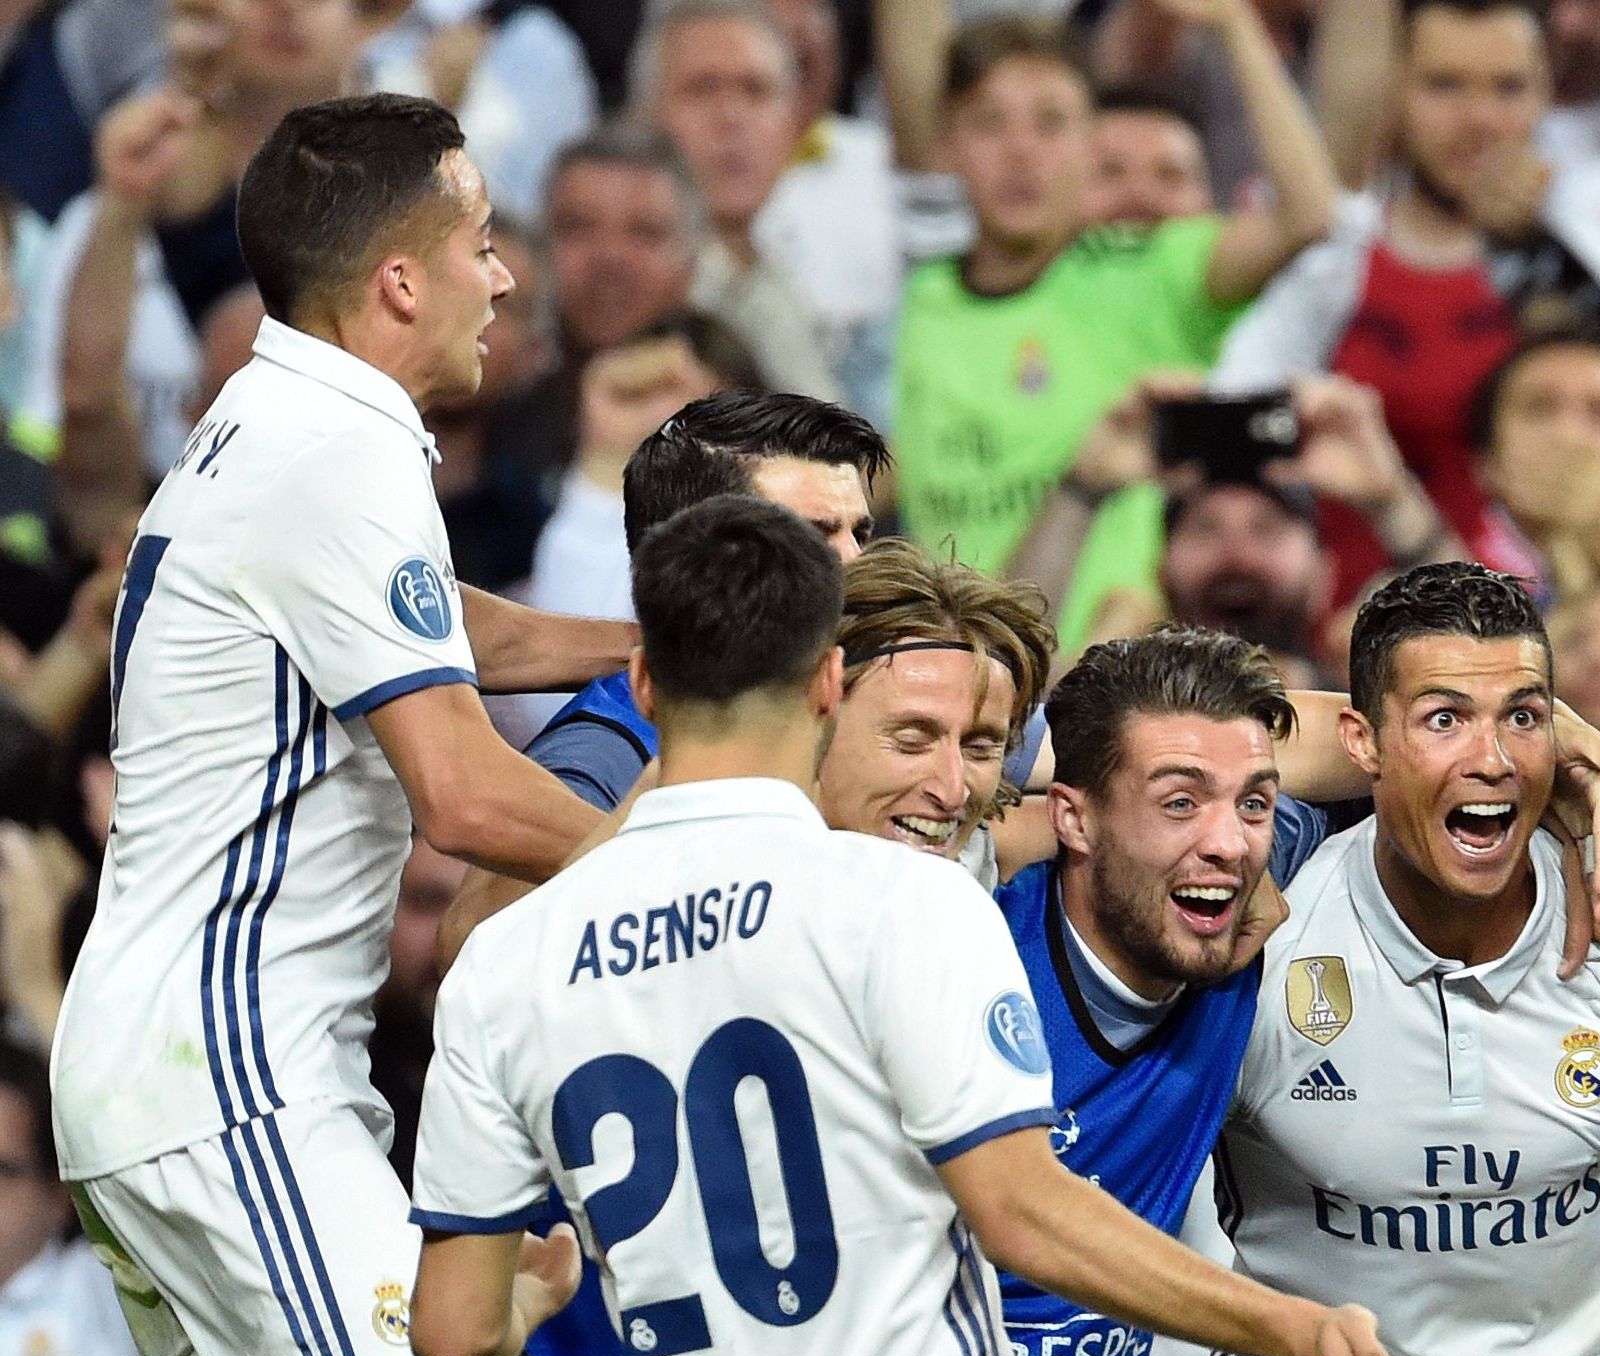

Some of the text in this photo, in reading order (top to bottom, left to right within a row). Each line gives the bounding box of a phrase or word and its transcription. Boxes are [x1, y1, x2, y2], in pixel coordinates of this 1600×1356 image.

[1306, 1011, 1337, 1025] FIFA
[1290, 1085, 1357, 1101] adidas
[1423, 1143, 1520, 1191] Fly
